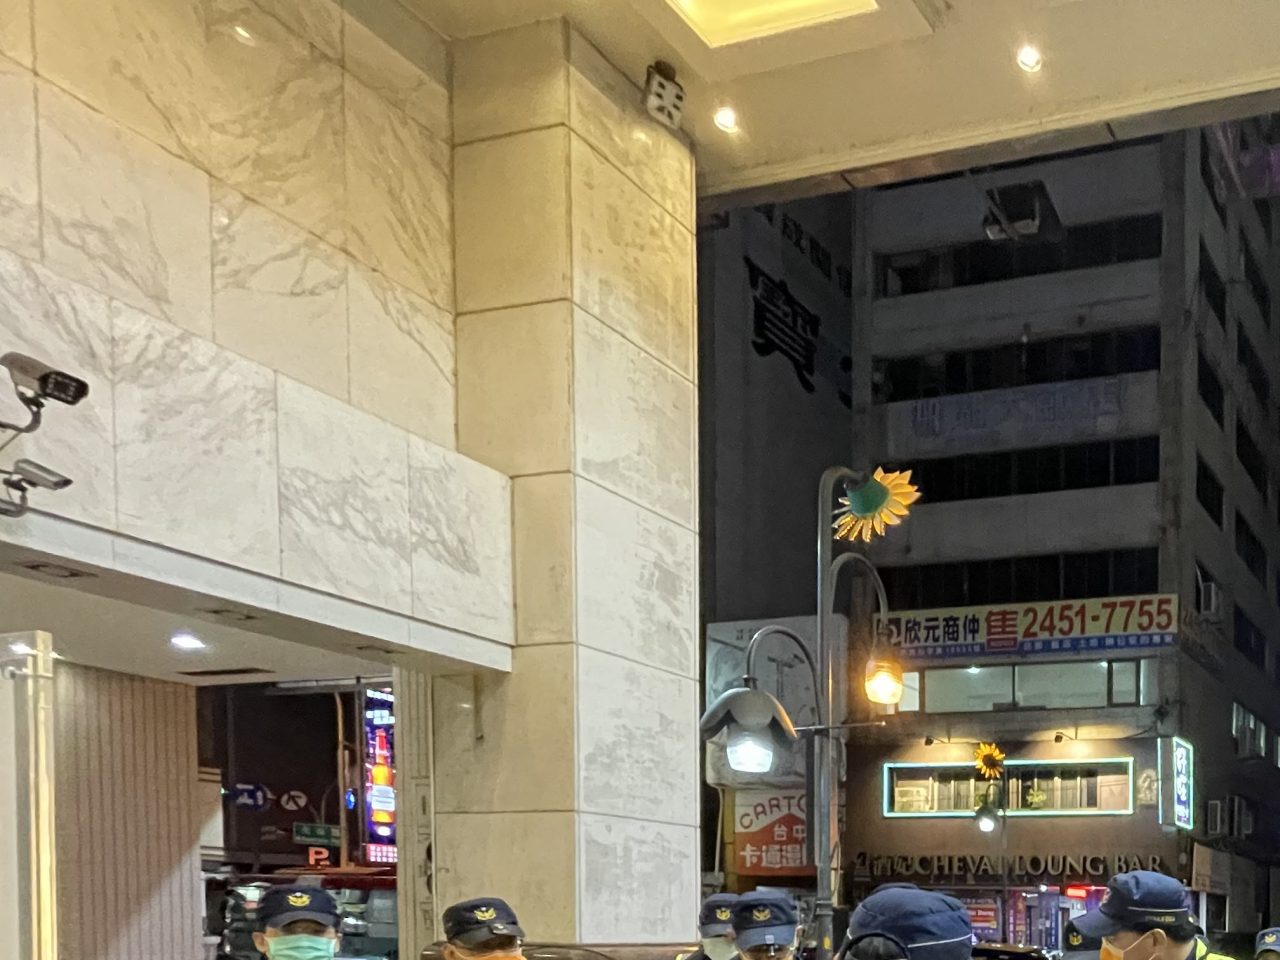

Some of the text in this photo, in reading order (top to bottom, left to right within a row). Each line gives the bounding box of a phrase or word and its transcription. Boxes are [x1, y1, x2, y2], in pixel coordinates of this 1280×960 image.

[1022, 597, 1173, 639] 2451-7755
[739, 843, 807, 868] 卡通漫
[1014, 854, 1104, 876] LOUNG
[1114, 852, 1162, 876] BAR
